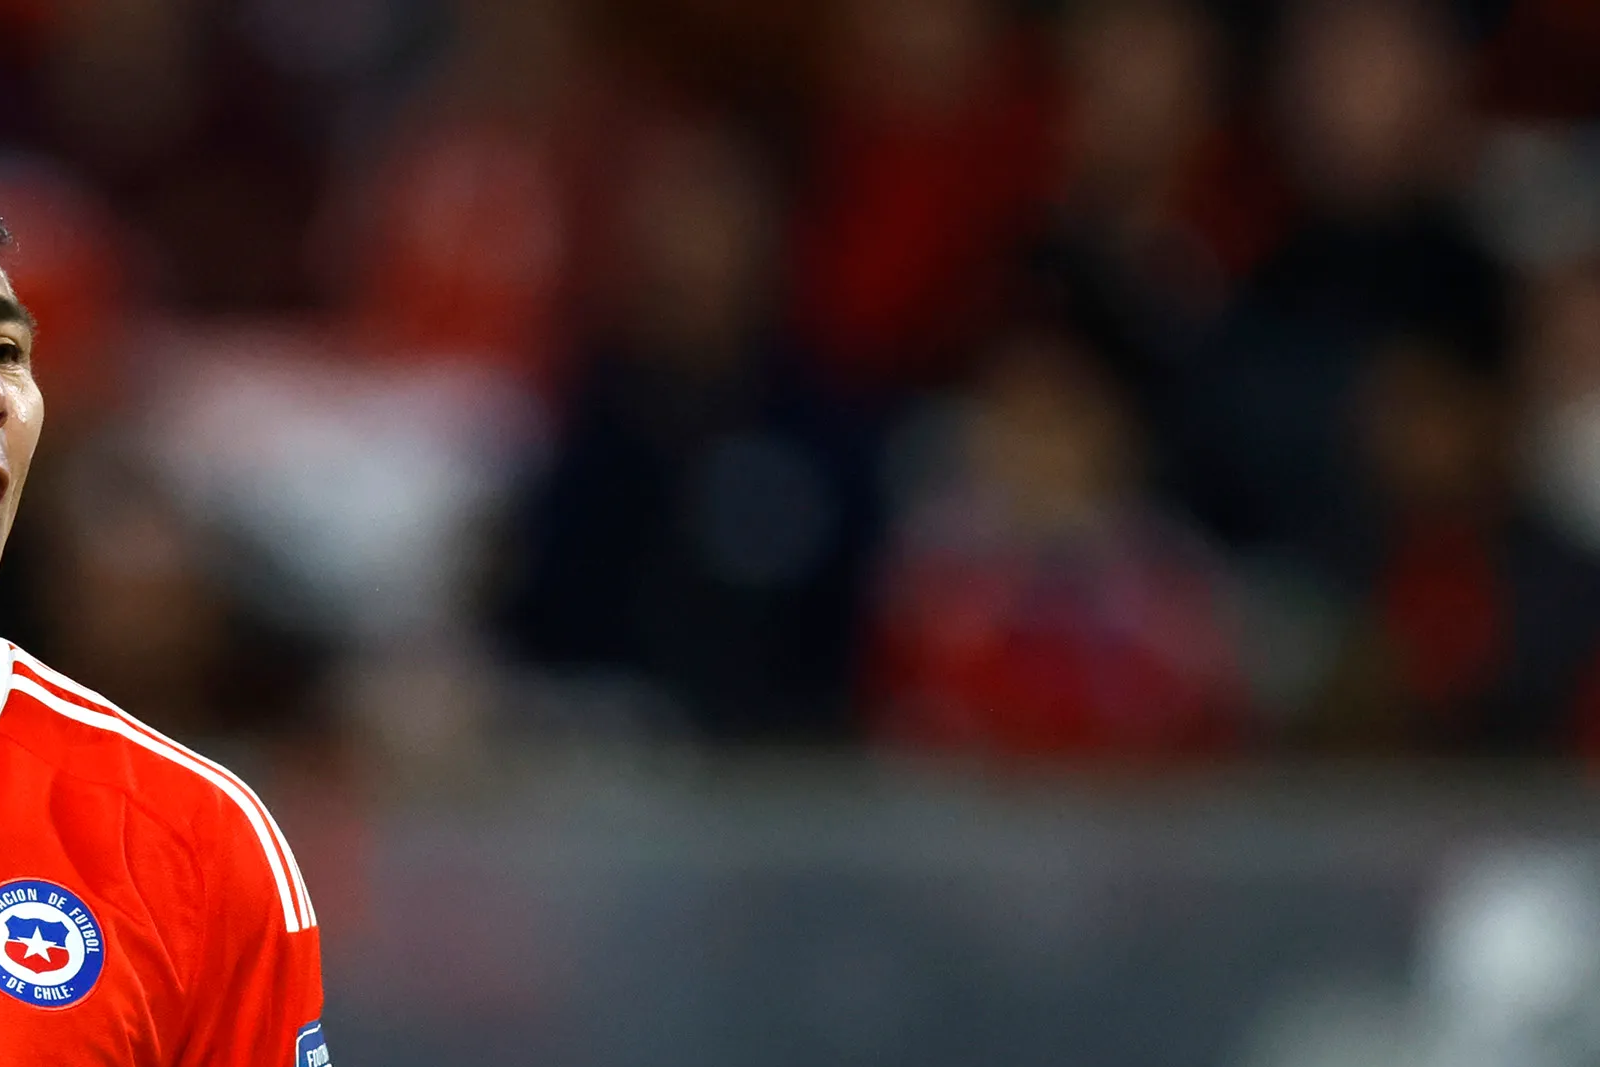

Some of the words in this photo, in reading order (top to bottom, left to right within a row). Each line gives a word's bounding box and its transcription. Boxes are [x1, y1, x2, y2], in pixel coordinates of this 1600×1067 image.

[48, 892, 67, 910] DE
[69, 907, 100, 954] FUTBOL
[6, 980, 26, 994] DE
[34, 984, 72, 1000] CHILE
